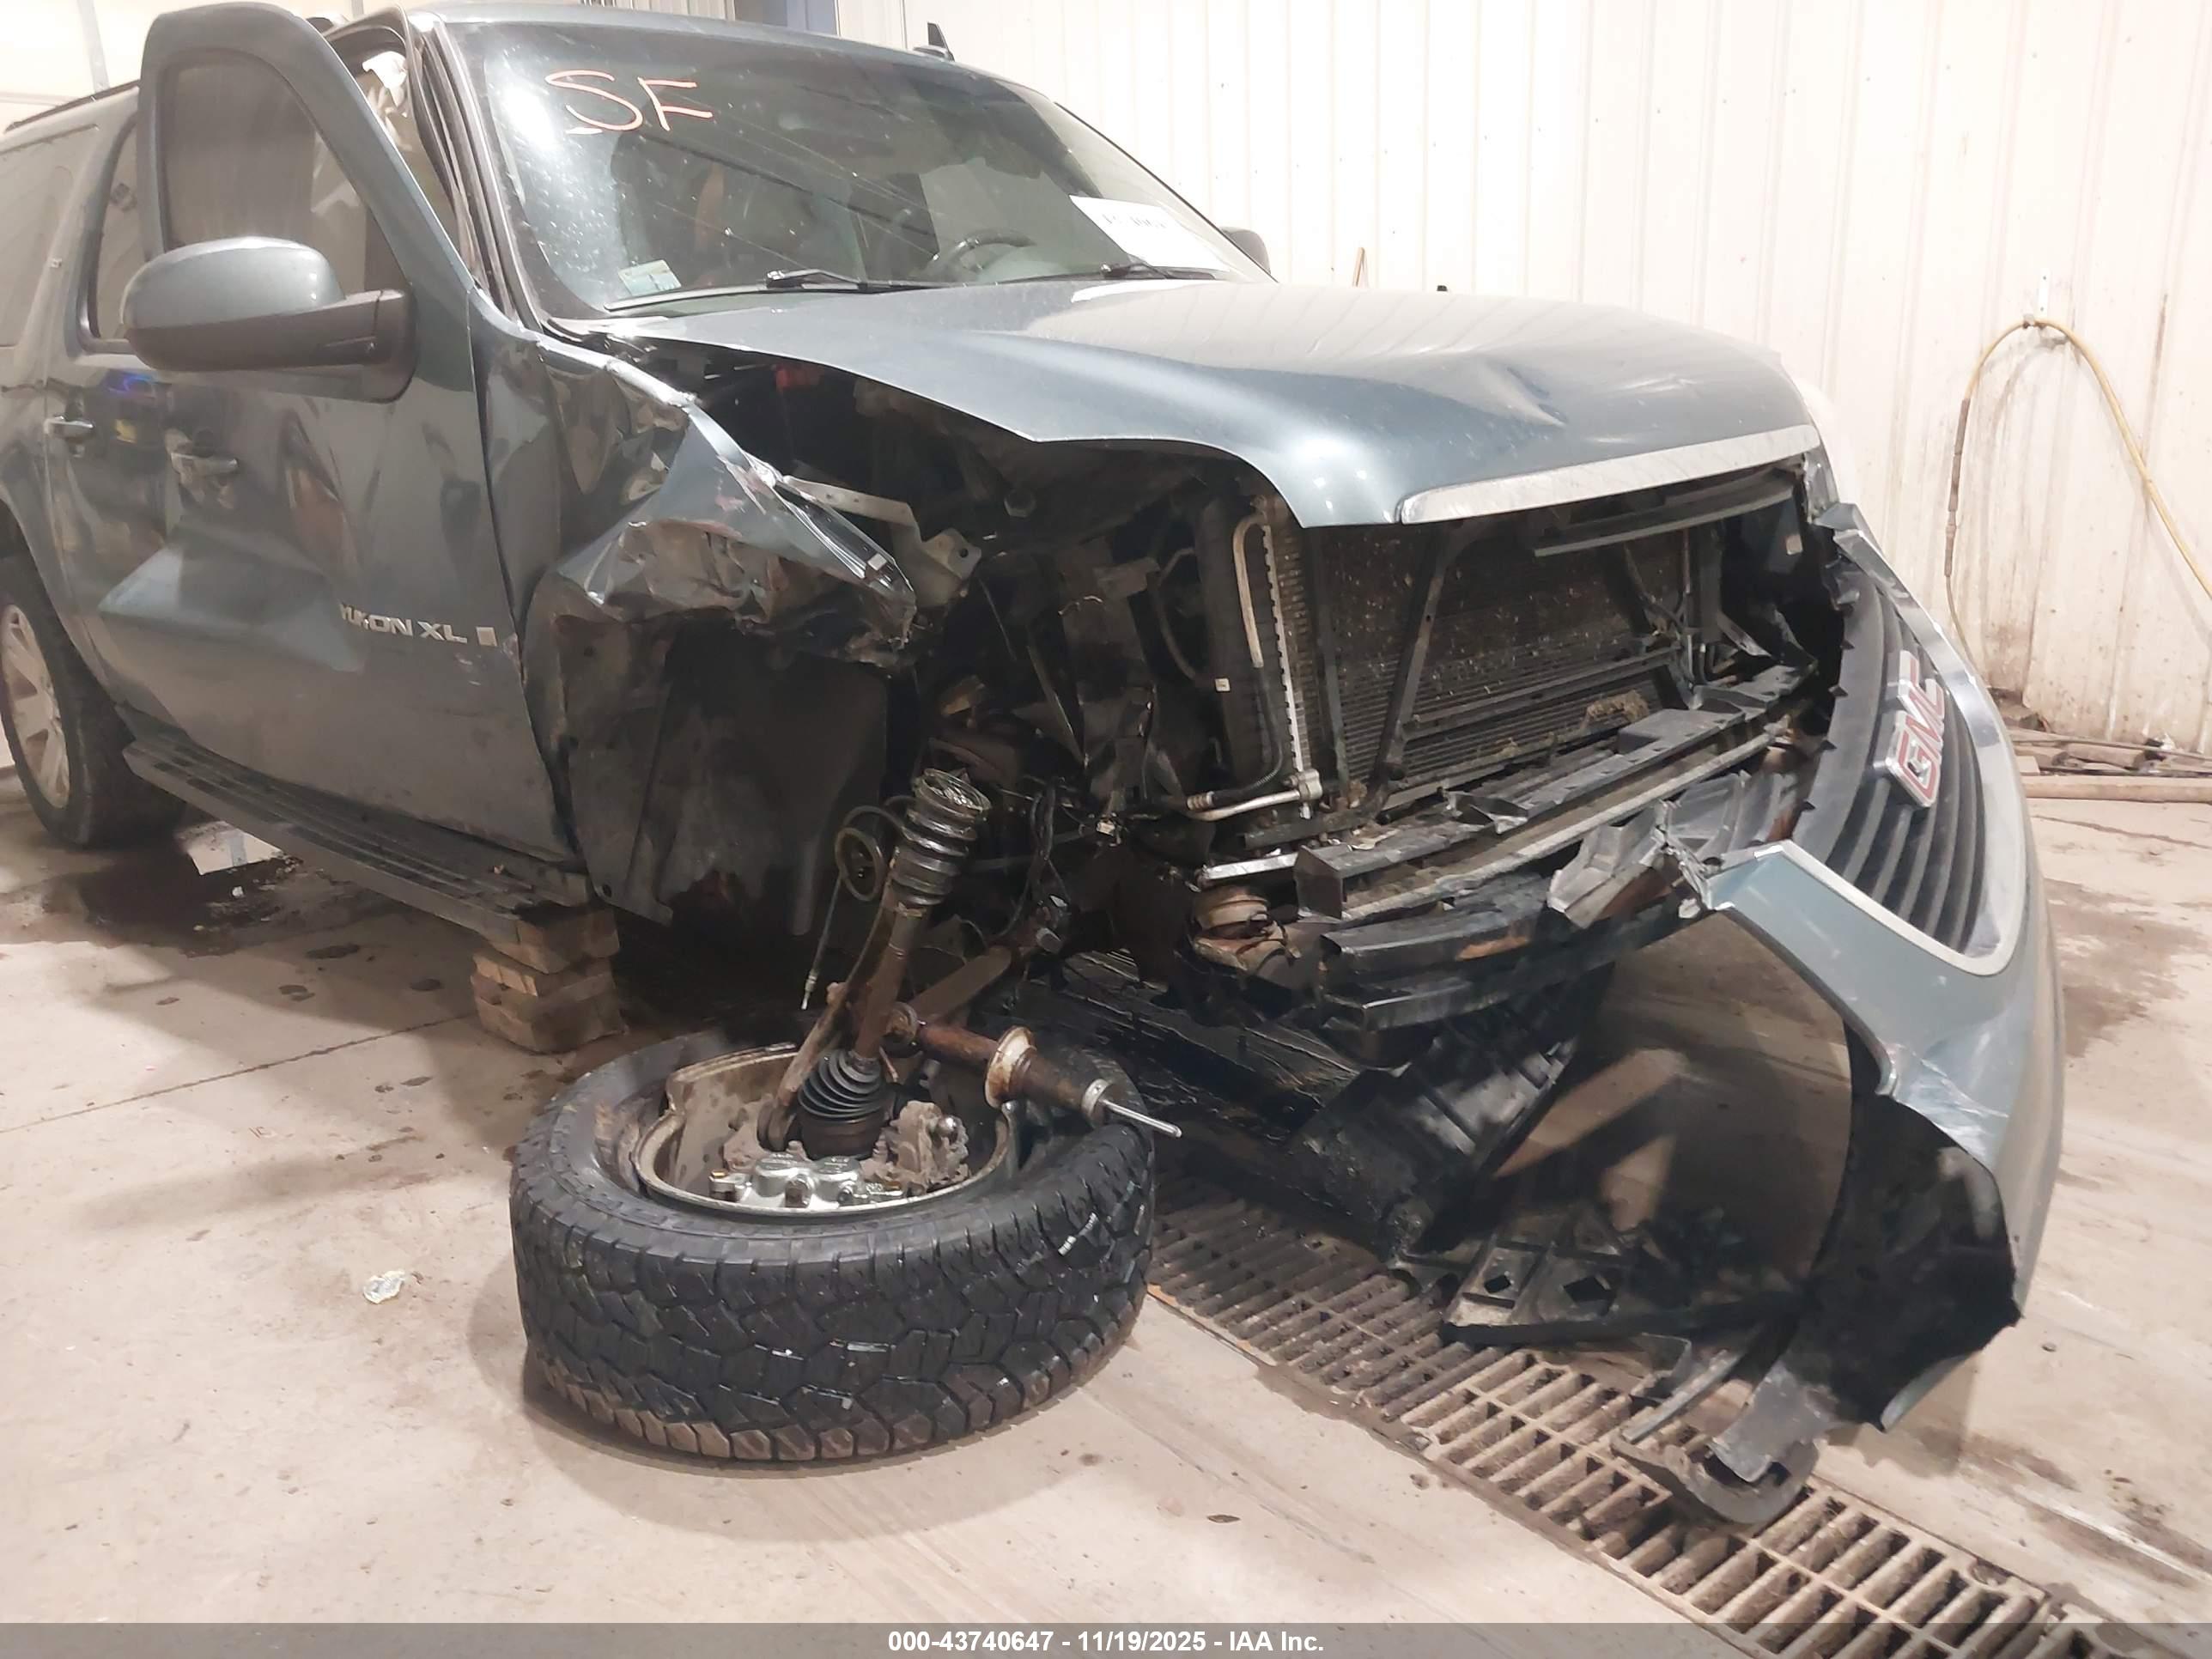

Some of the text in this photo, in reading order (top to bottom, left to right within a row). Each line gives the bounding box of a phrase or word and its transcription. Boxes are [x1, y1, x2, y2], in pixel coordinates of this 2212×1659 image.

[544, 70, 714, 131] SF
[339, 604, 468, 644] YUKON XL
[1887, 650, 1945, 807] GMC
